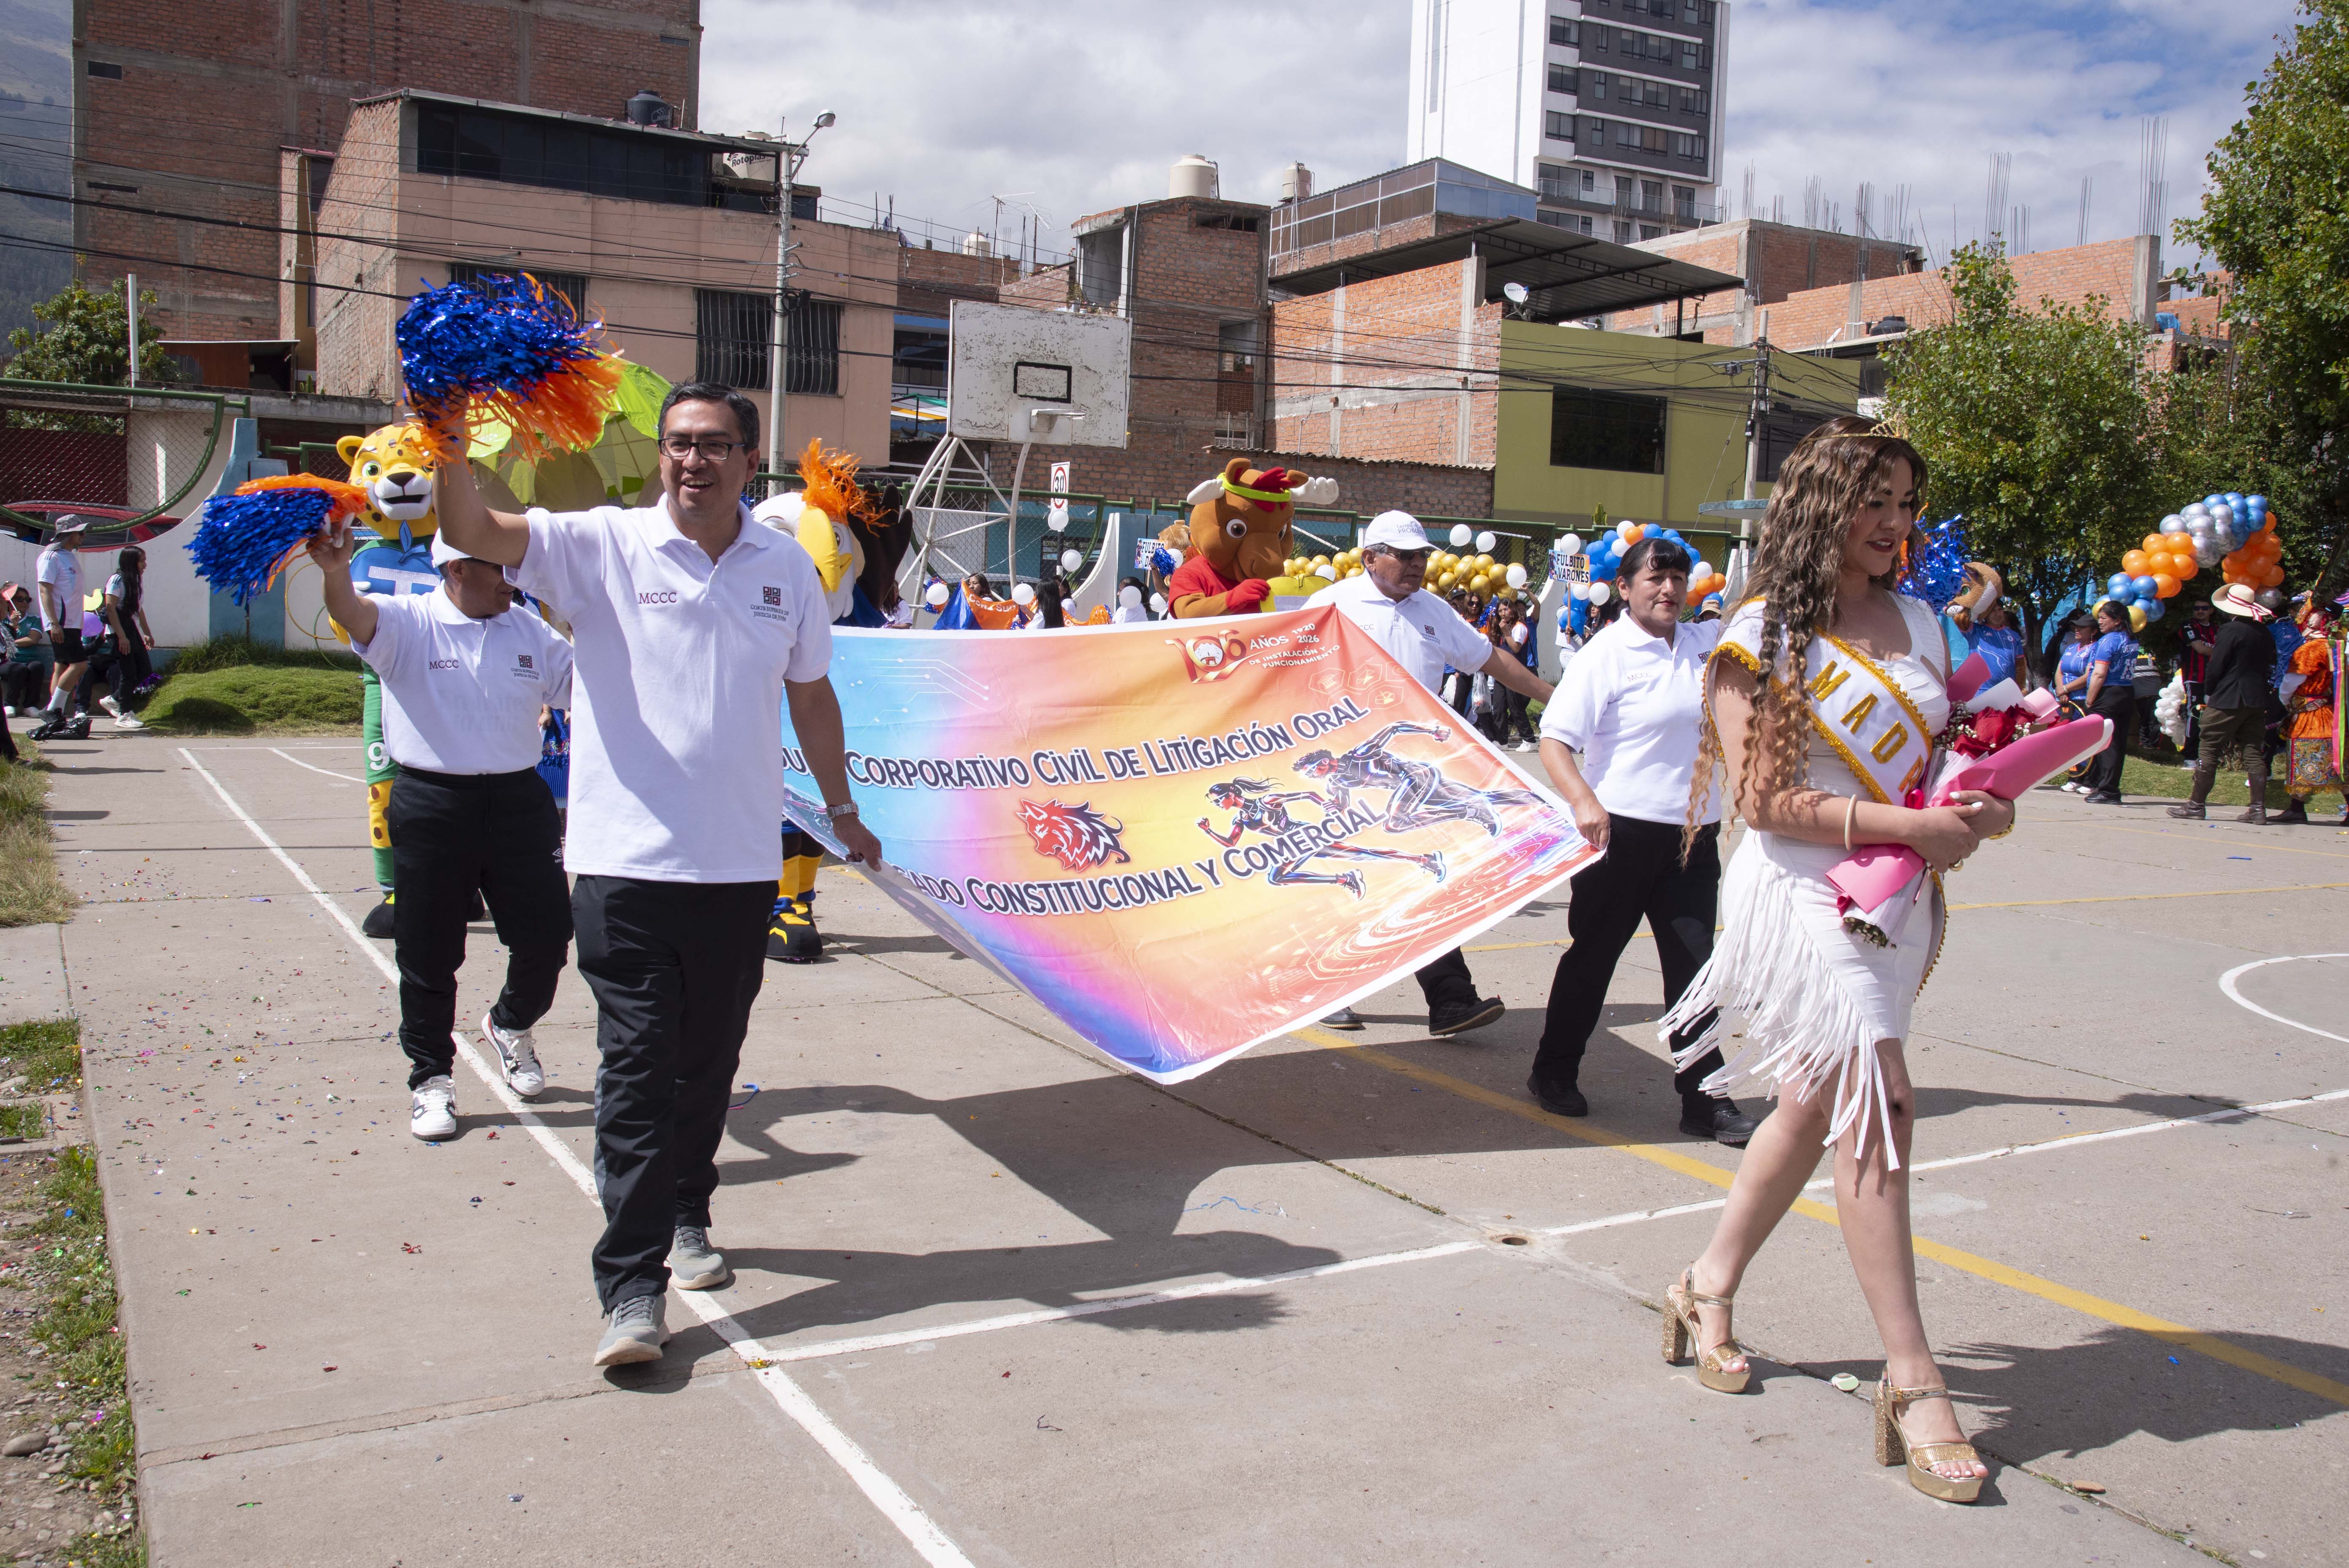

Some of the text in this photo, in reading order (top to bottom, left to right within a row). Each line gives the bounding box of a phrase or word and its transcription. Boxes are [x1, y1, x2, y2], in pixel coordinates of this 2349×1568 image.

[732, 154, 765, 167] Rotoplas
[1055, 476, 1064, 493] 30
[1557, 554, 1585, 569] FULBITO
[369, 567, 428, 583] DERECHO
[1558, 567, 1589, 583] VARONES
[638, 592, 677, 604] MCCC
[1250, 623, 1316, 650] AÑOS 1920
[1296, 634, 1320, 644] 2026
[1262, 644, 1340, 668] FUNCIONAMIENTO
[1263, 646, 1318, 662] INSTALACIÓN
[429, 660, 459, 669] MCCC
[845, 751, 1029, 787] CORPORATIVO
[1034, 748, 1105, 784] CIVIL
[1104, 747, 1146, 779] DE
[1142, 722, 1293, 775] LITIGACIÓN
[1293, 696, 1371, 740] ORAL
[368, 742, 390, 771] 9
[964, 868, 1204, 915] CONSTITUCIONAL
[1194, 858, 1223, 887] Y
[1223, 797, 1387, 879] COMERCIAL
